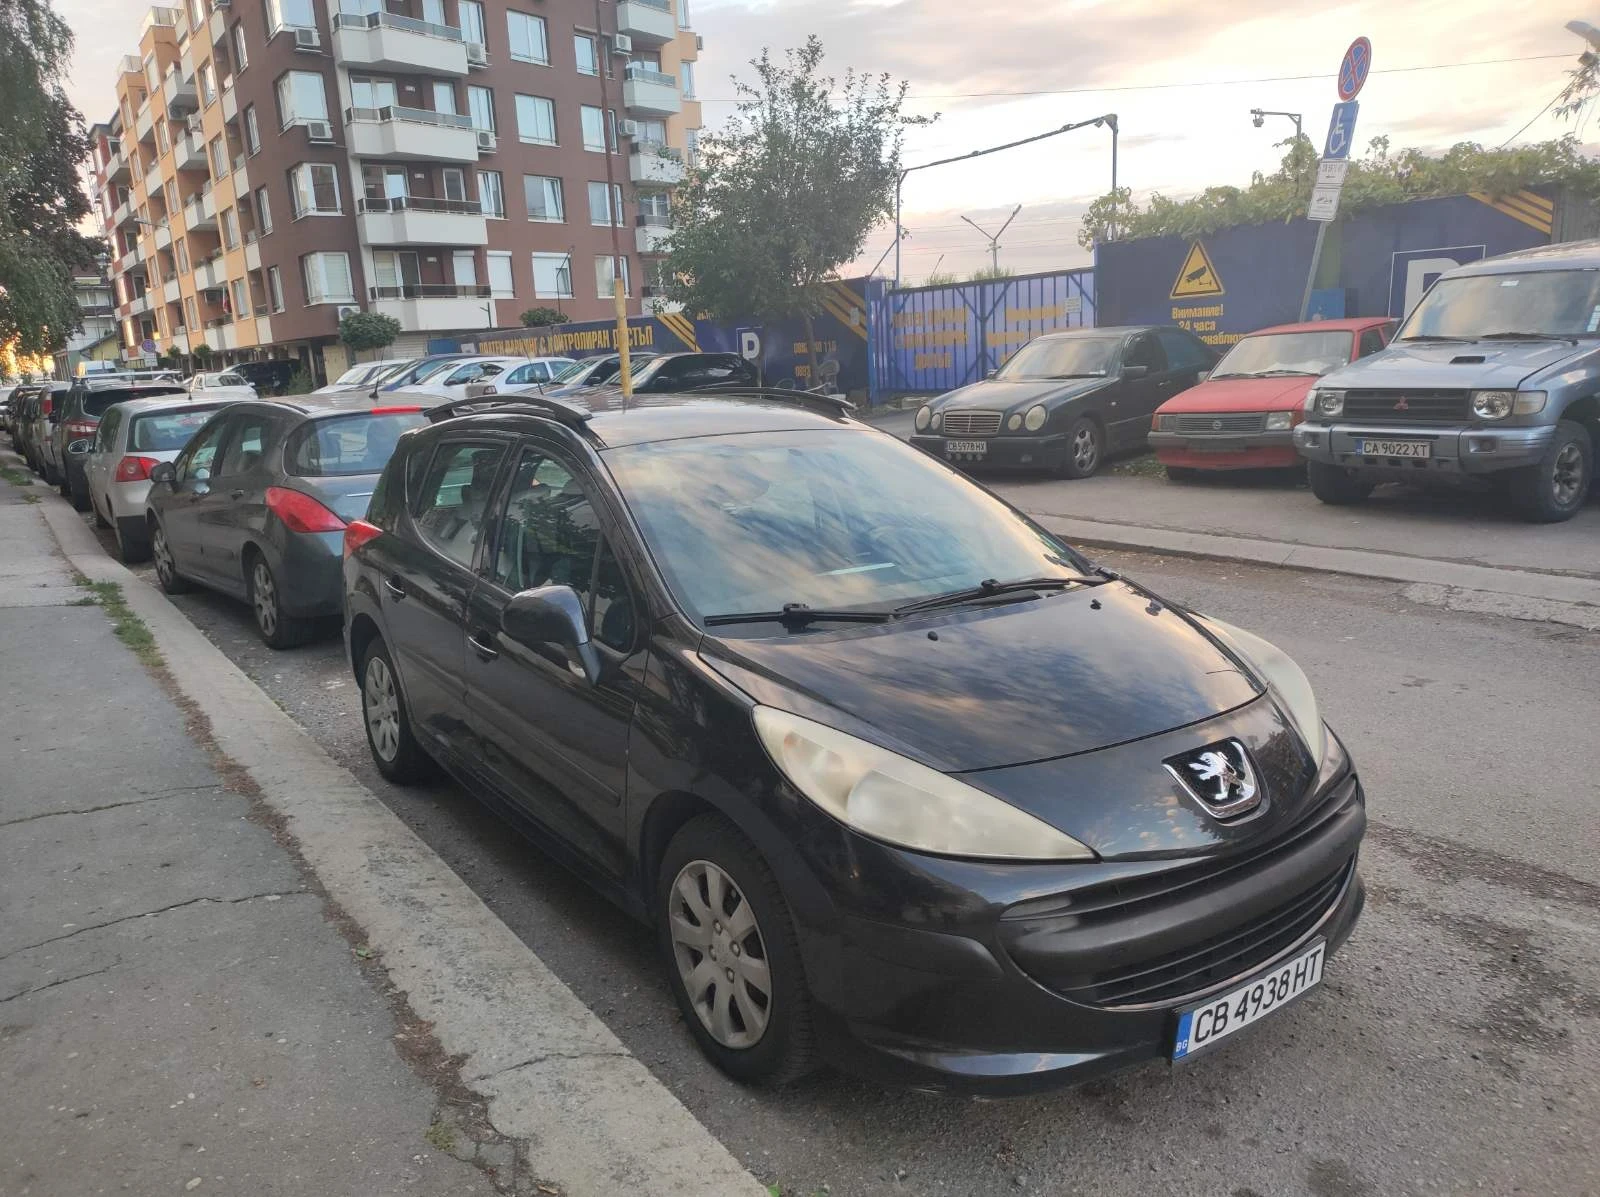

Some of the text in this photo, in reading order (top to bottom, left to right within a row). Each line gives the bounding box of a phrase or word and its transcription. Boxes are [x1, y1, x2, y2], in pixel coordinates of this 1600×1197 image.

[1172, 304, 1224, 319] Внимание!
[1193, 320, 1217, 331] часа
[1363, 442, 1379, 454] CA
[1381, 443, 1410, 456] 9022
[1412, 444, 1427, 457] XT
[1194, 948, 1322, 1043] CB 4938 HT
[1175, 1039, 1188, 1053] BG
